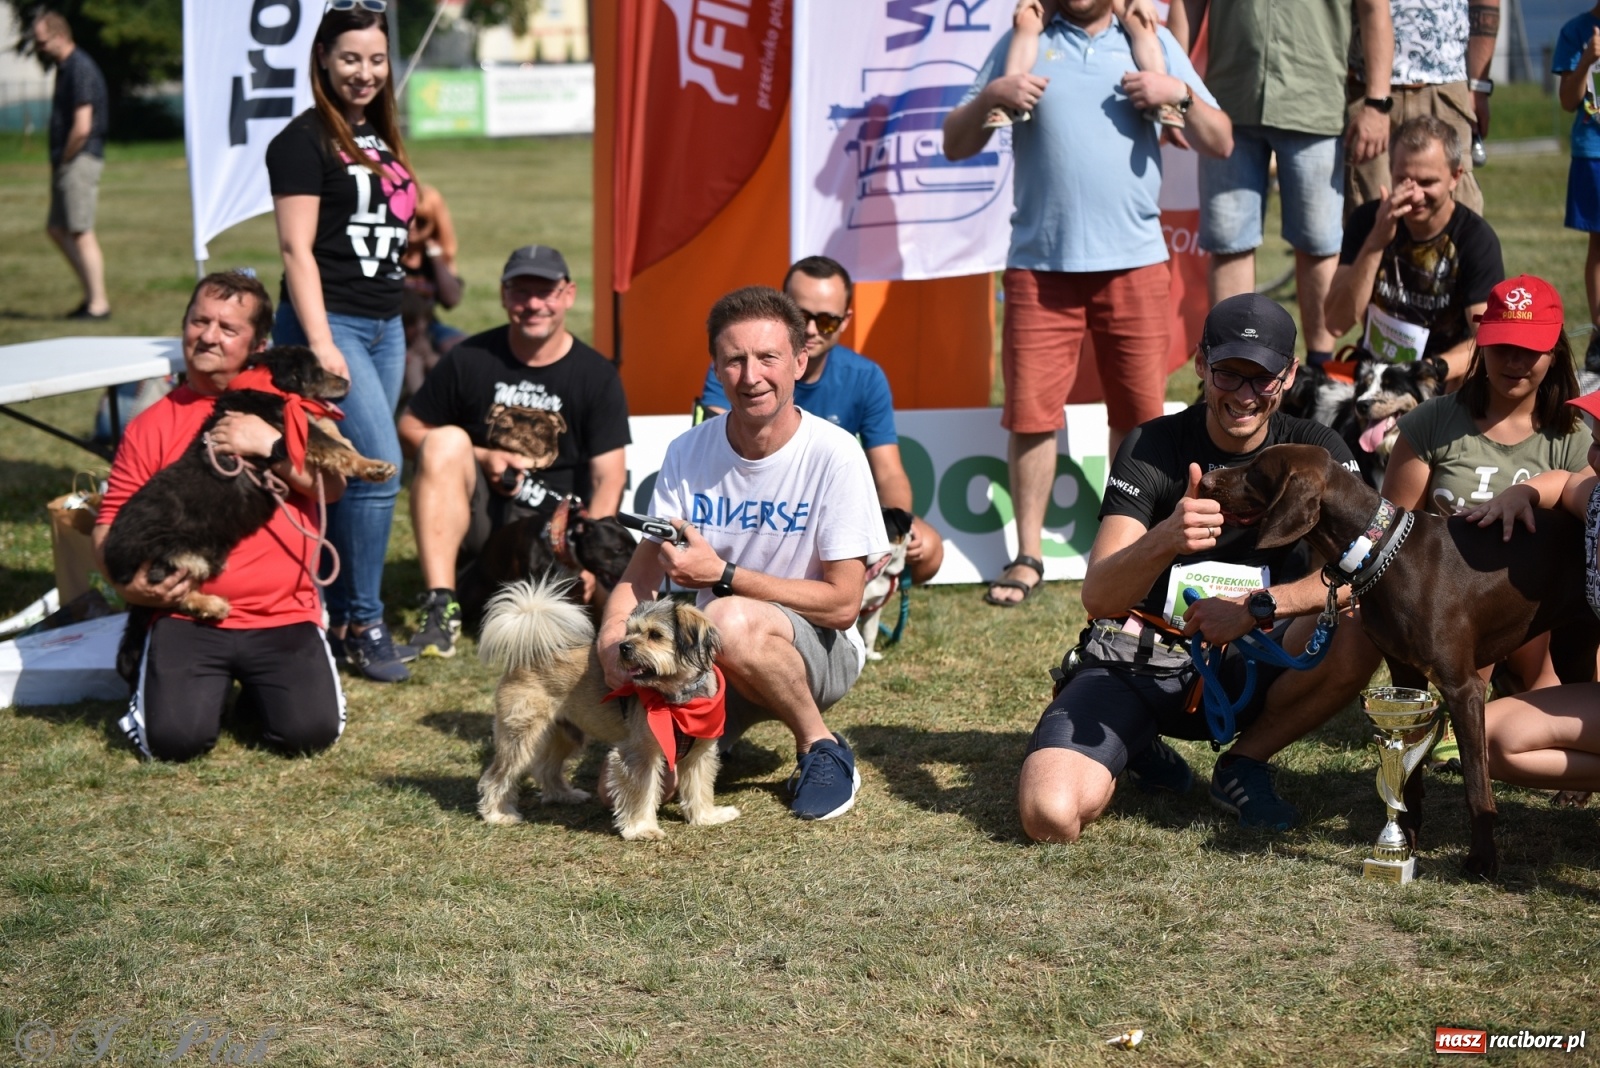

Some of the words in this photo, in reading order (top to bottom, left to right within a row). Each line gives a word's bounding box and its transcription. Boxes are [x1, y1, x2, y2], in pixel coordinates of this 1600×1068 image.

[1502, 310, 1533, 320] POLSKA
[1382, 341, 1397, 359] 18
[494, 381, 563, 412] Merrier
[691, 493, 809, 532] DIVERSE
[1185, 572, 1261, 588] DOGTREKKING
